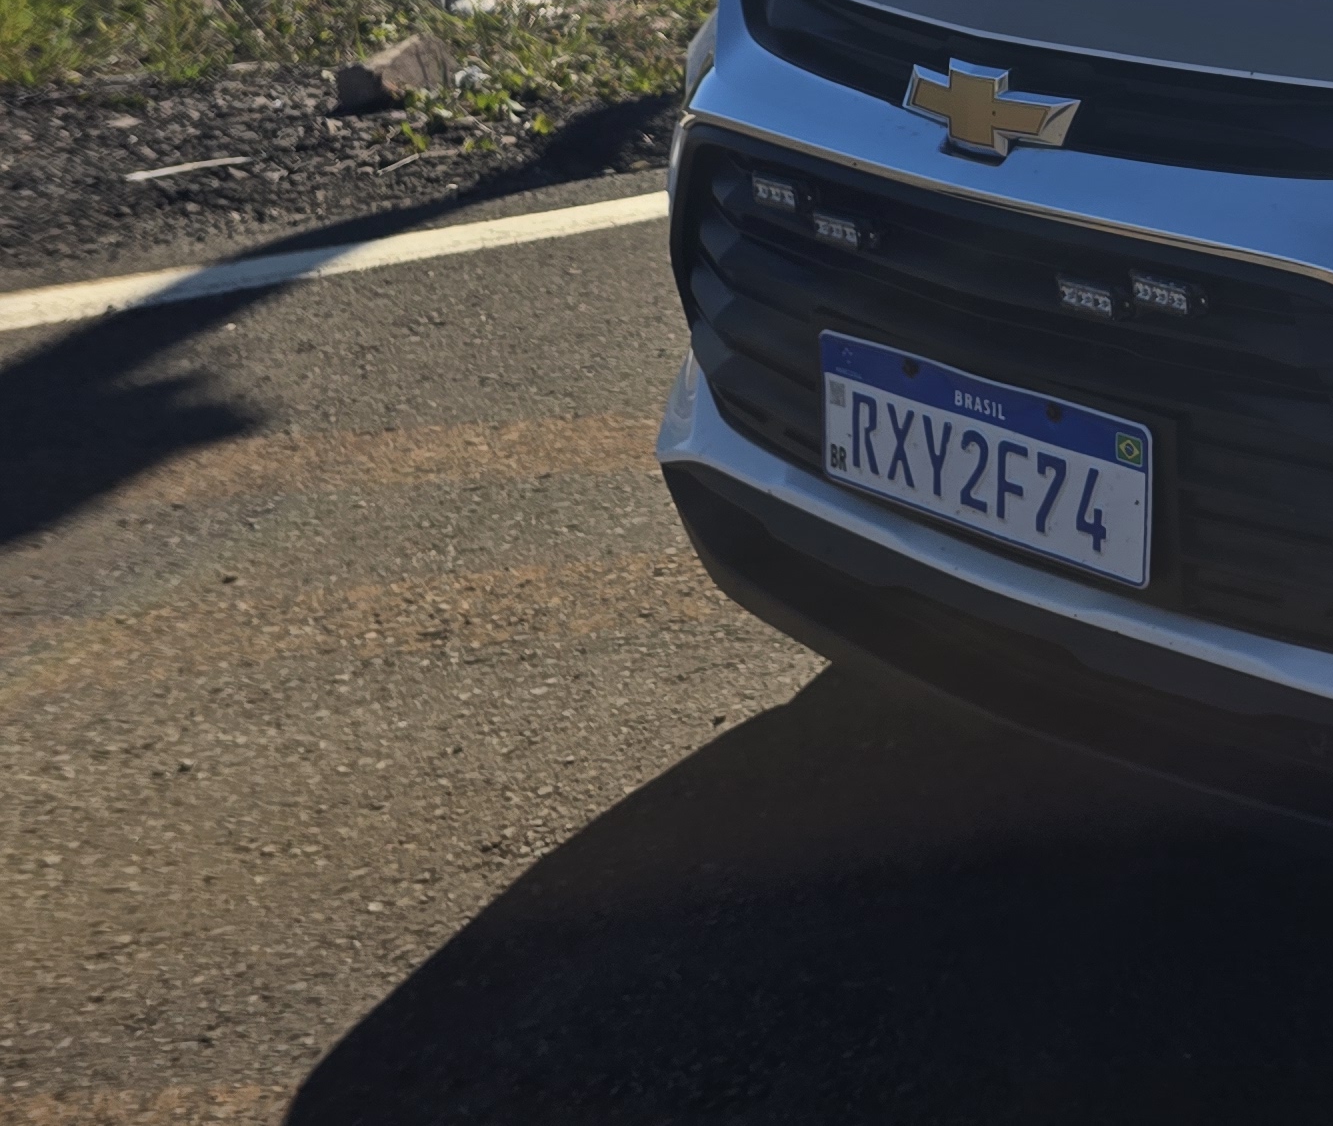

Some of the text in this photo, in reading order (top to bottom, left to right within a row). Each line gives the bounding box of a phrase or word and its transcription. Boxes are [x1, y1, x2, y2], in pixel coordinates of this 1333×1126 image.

[953, 389, 1007, 422] BRASIL
[829, 442, 848, 473] BR
[851, 390, 1108, 554] RXY2F74
